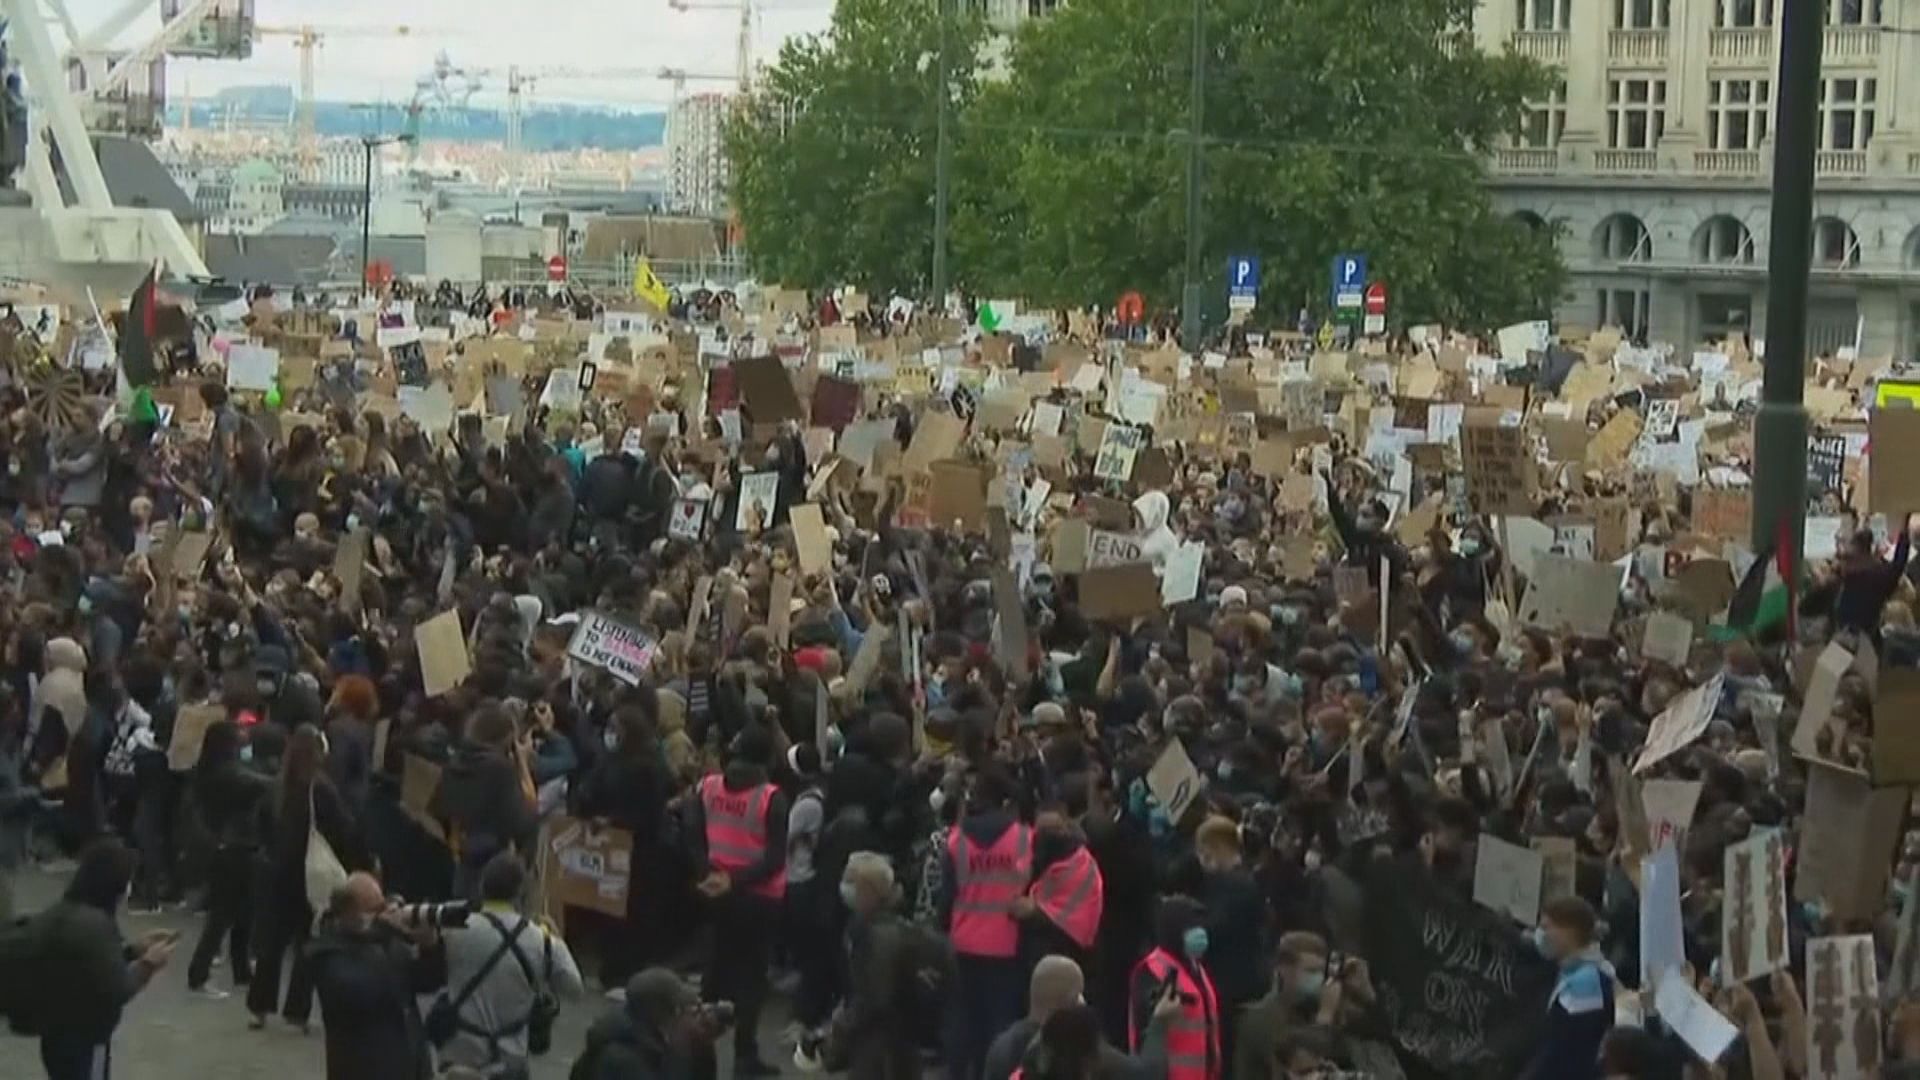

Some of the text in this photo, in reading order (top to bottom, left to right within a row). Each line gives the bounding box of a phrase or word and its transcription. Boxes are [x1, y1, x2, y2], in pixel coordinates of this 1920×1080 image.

[1237, 260, 1250, 285] P
[1344, 259, 1357, 283] P
[1094, 535, 1141, 560] END
